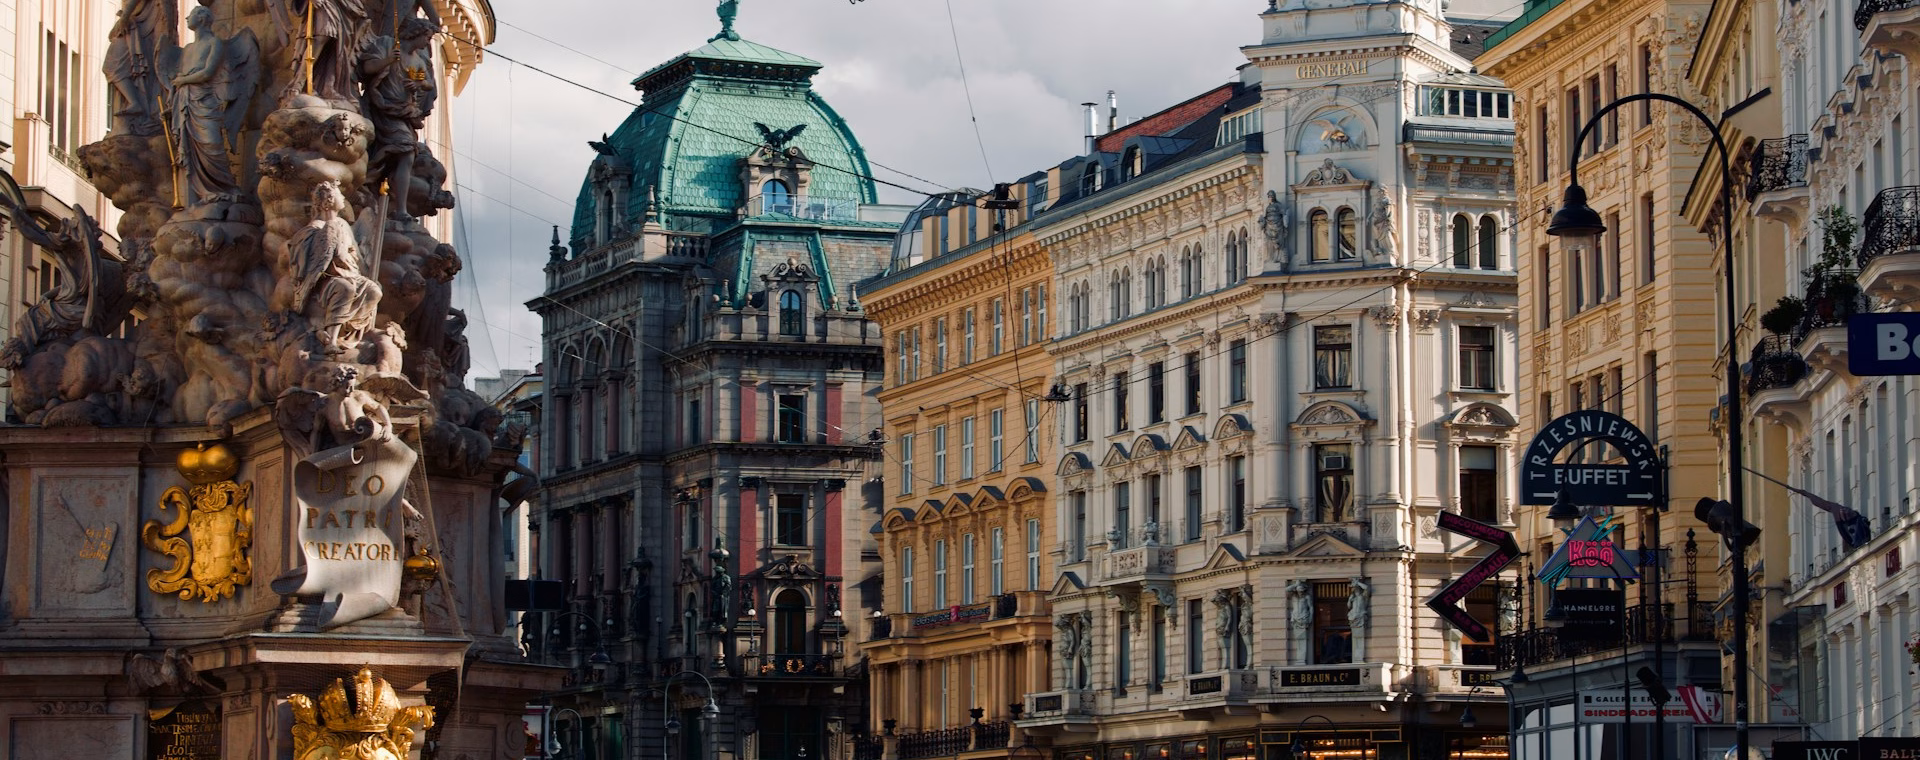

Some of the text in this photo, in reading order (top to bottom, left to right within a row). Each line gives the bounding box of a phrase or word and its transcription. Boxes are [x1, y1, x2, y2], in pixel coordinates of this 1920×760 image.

[1295, 59, 1369, 80] GENERALI
[1877, 323, 1920, 361] B
[316, 470, 385, 496] DEO
[1554, 468, 1630, 485] BUFFET
[306, 507, 393, 529] PATRI
[1568, 540, 1615, 567] Köö
[1563, 604, 1616, 612] HANNELORE
[1290, 673, 1298, 683] E.
[1300, 672, 1331, 683] BRAUN
[1806, 748, 1848, 760] IWC
[1880, 748, 1920, 759] BALL
